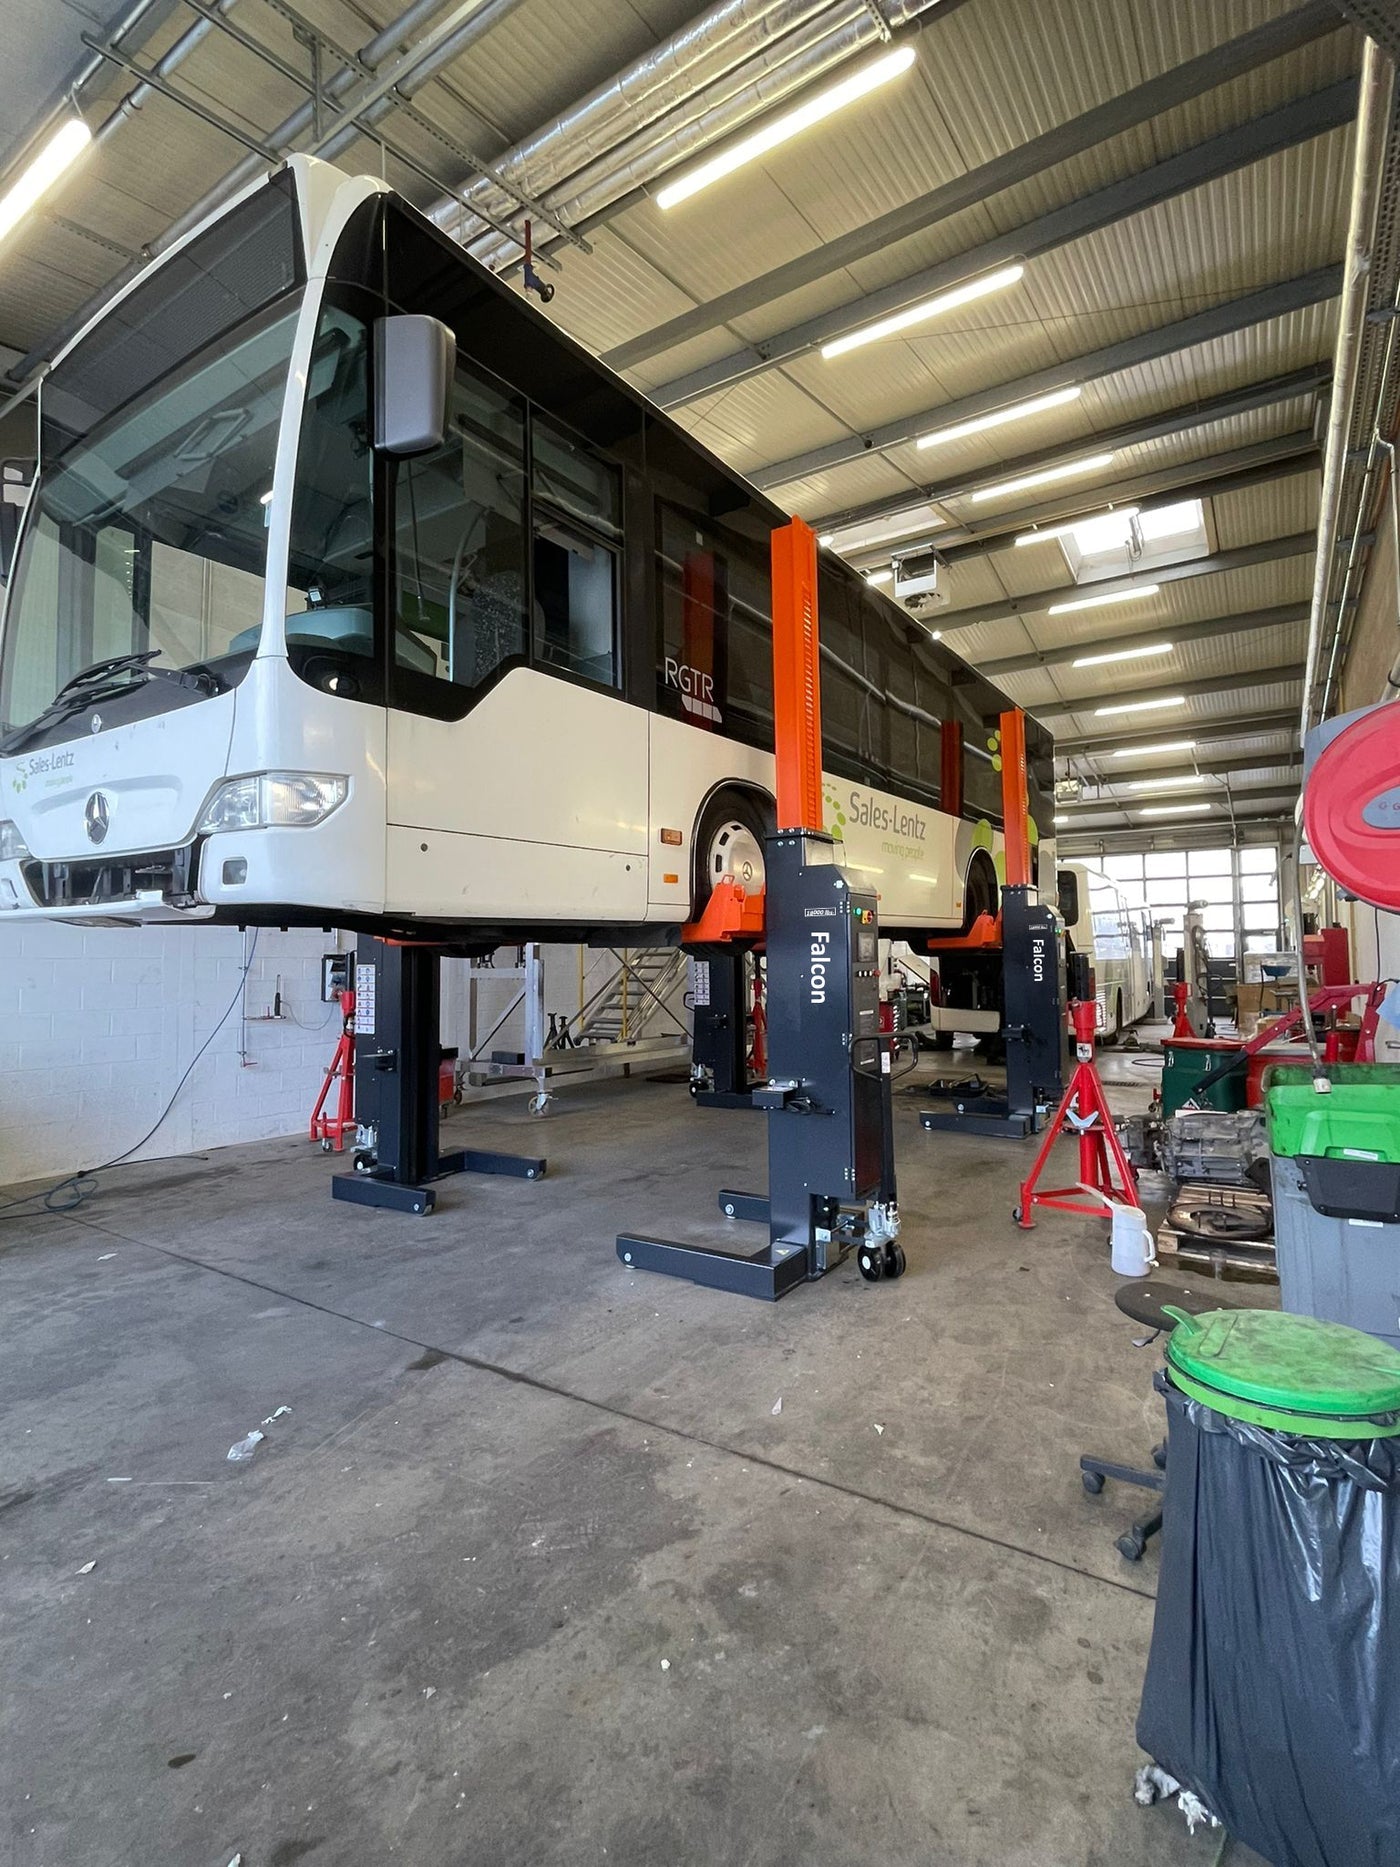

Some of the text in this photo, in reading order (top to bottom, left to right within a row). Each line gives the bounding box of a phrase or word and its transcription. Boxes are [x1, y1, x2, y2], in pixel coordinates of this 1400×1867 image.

[665, 657, 714, 702] RGTR
[811, 932, 831, 1004] Falcon
[1032, 939, 1045, 982] Falcon
